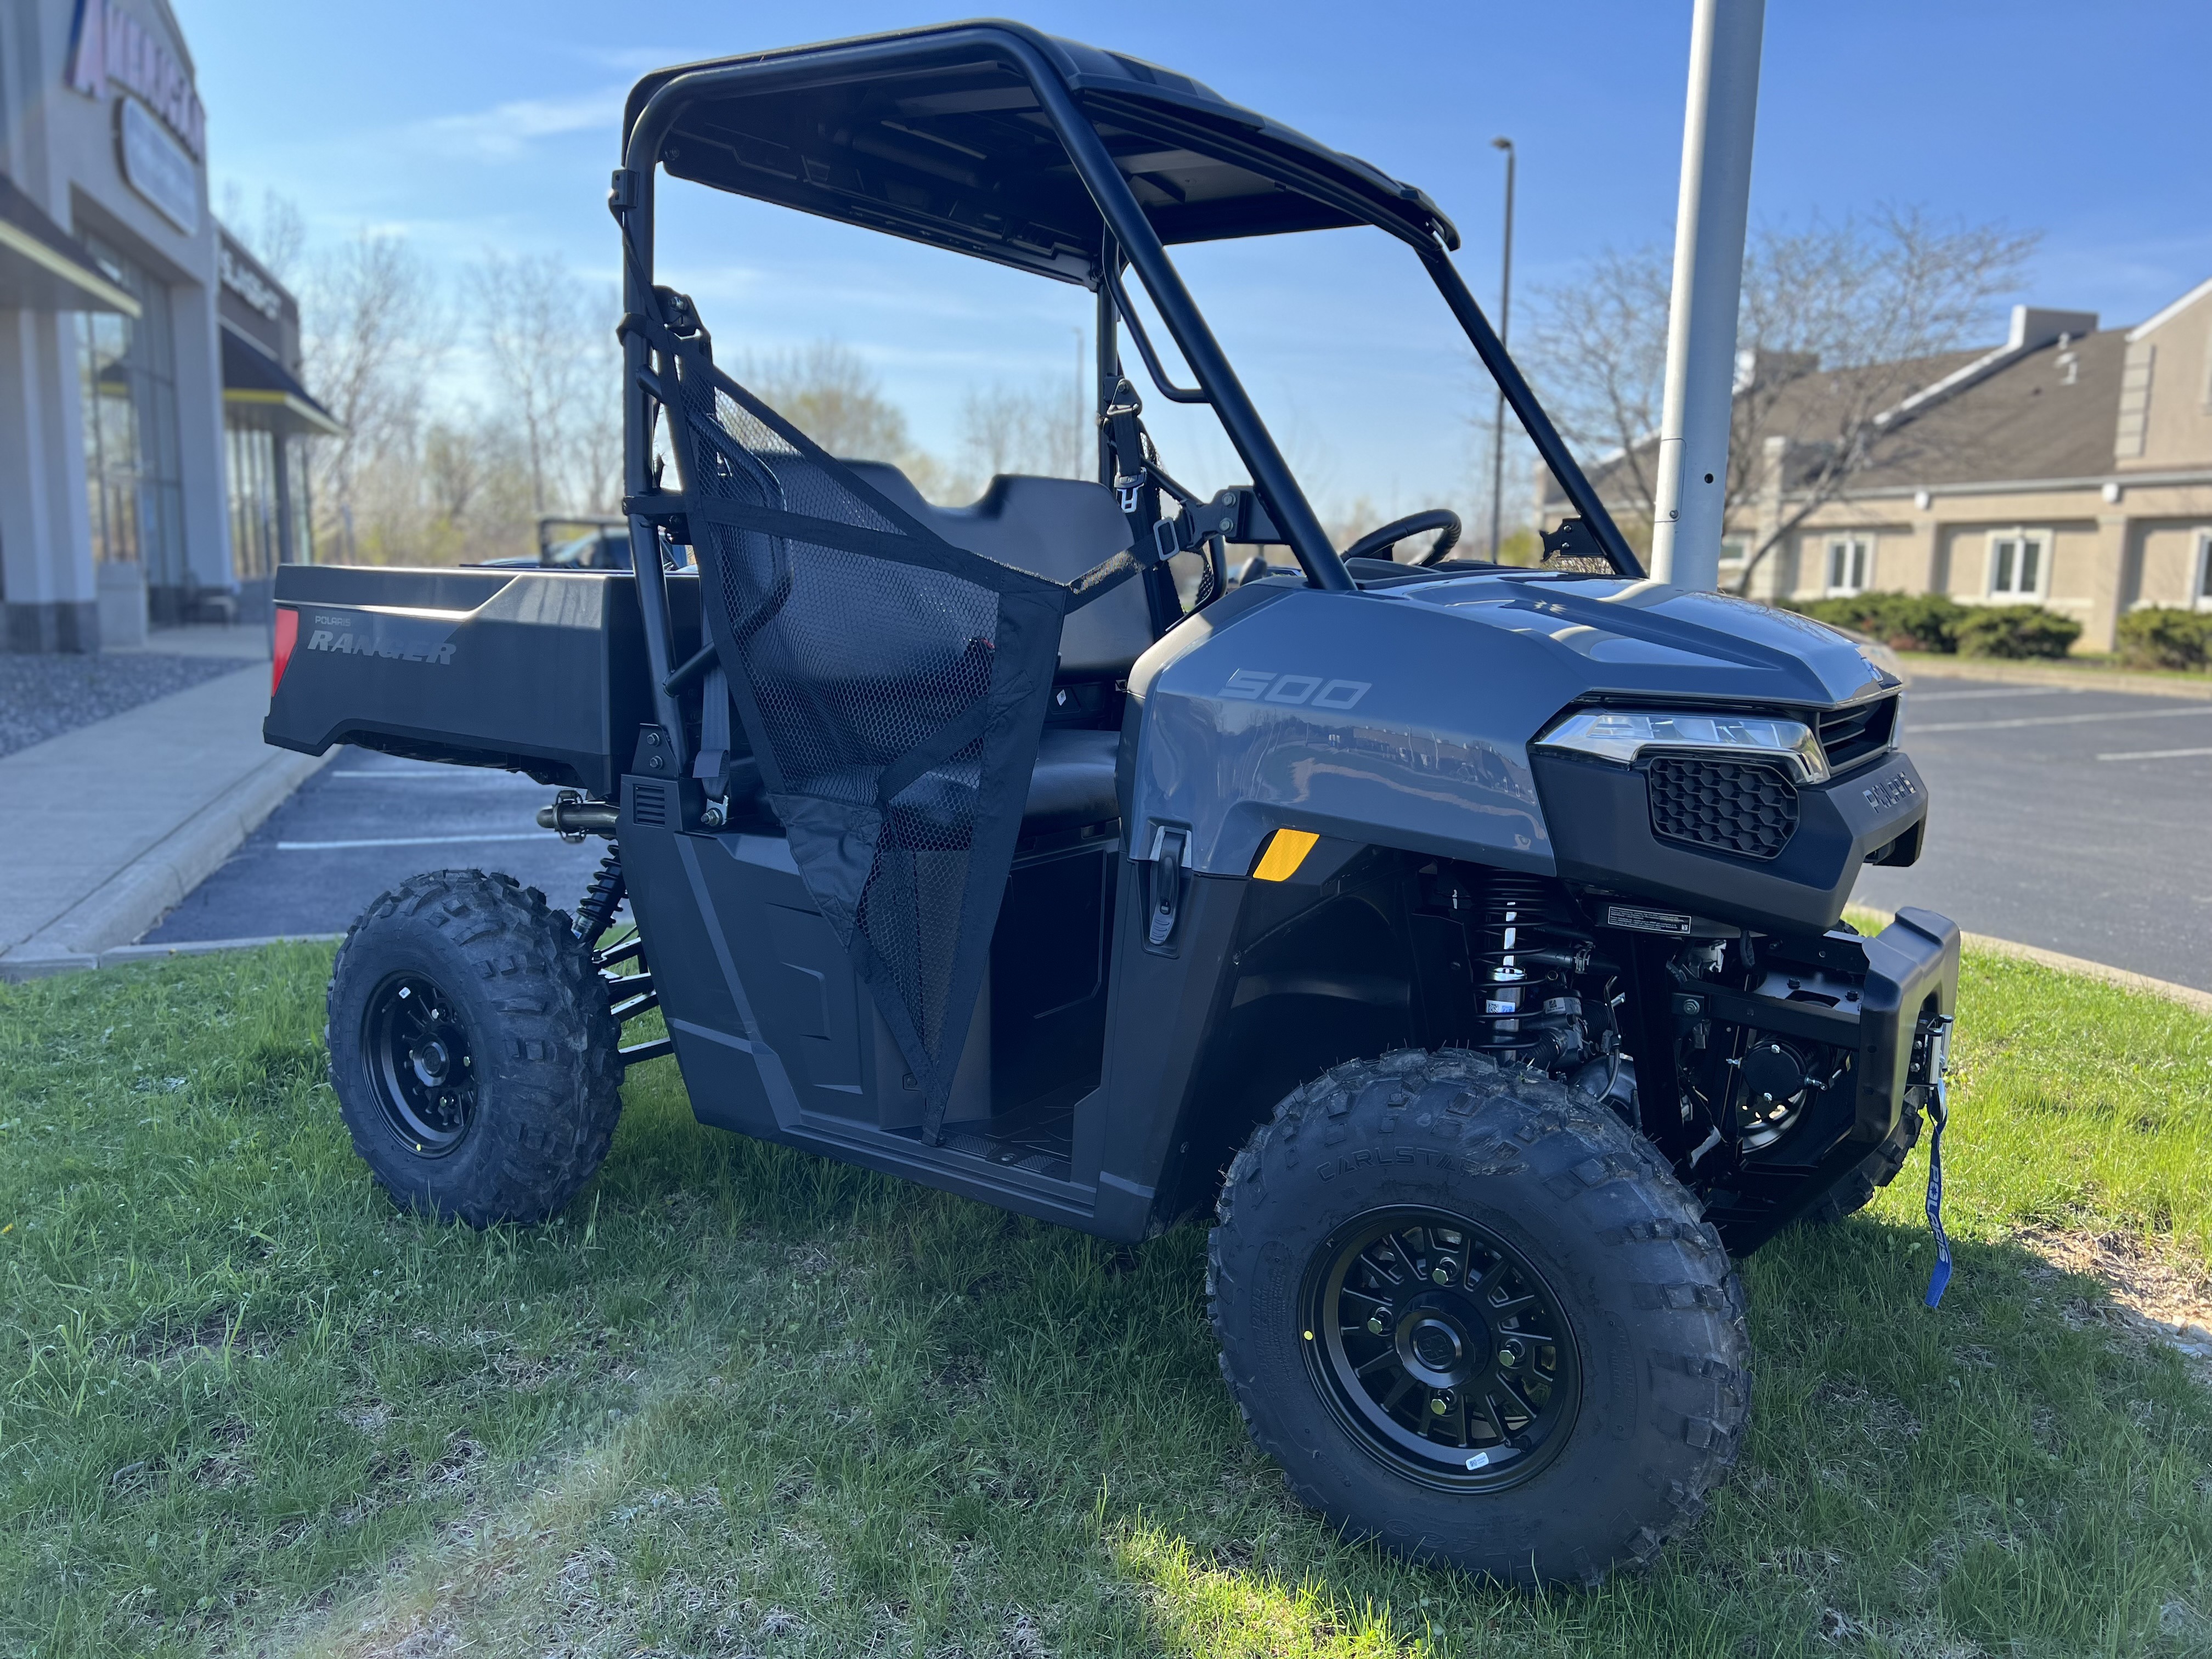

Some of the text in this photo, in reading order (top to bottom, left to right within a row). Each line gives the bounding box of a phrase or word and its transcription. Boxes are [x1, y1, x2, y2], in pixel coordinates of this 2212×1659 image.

[315, 615, 351, 627] POLARIS
[307, 630, 456, 665] RANGER
[1216, 668, 1373, 710] 500
[1862, 771, 1916, 814] POLARIS
[1927, 1164, 1949, 1263] POLARIS
